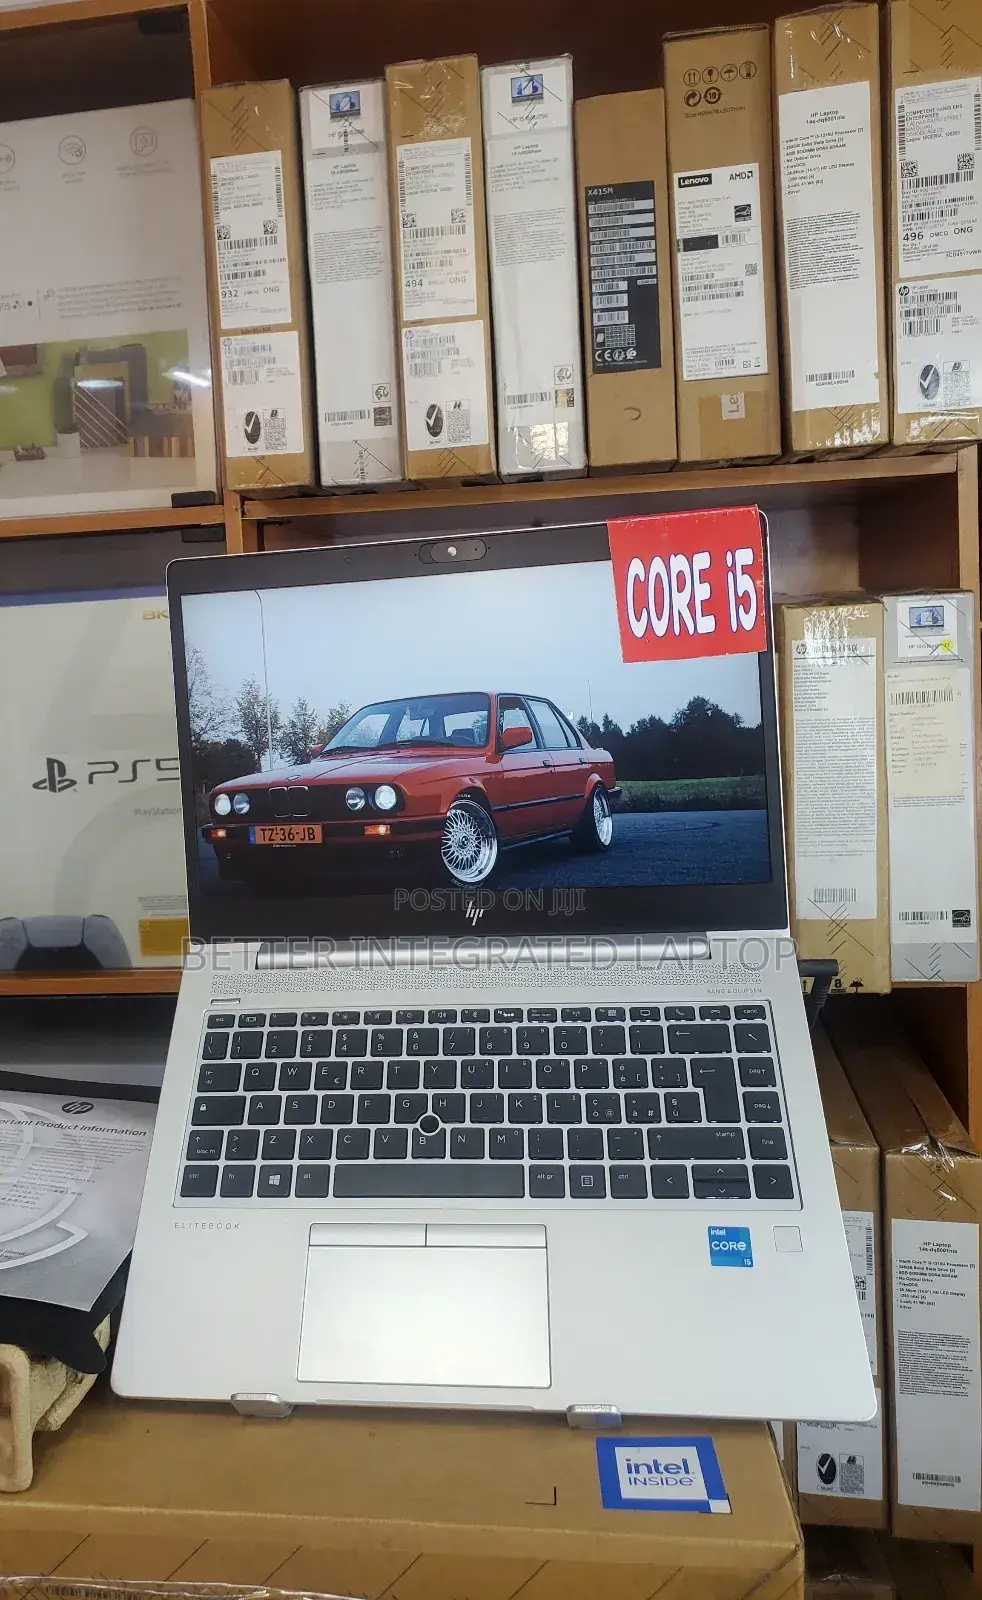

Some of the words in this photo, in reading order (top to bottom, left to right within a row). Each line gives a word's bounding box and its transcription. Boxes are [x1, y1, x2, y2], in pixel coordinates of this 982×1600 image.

[819, 109, 839, 117] Laptop
[906, 107, 935, 117] COMPETENT
[936, 103, 963, 111] HANDLERS
[906, 113, 940, 121] ENTERPRISES
[680, 176, 709, 186] Lenovo
[729, 171, 747, 181] AMD
[587, 187, 614, 196] X415M
[903, 231, 924, 242] 496
[954, 226, 974, 235] ONG
[405, 279, 423, 288] 494
[449, 276, 467, 284] ONG
[221, 289, 238, 298] 932
[263, 285, 280, 294] ONG
[626, 555, 716, 639] CORE
[725, 547, 757, 634] i5
[87, 757, 180, 785] PS5
[251, 1068, 260, 1076] Q
[431, 1066, 438, 1074] Y
[468, 1066, 475, 1074] U
[581, 1065, 588, 1073] P
[256, 1101, 264, 1109] A
[292, 1101, 299, 1109] S
[328, 1101, 336, 1109] D
[364, 1100, 371, 1108] F
[439, 1099, 447, 1107] H
[35, 1120, 81, 1131] Product
[80, 1124, 147, 1137] Information
[306, 1135, 314, 1143] X
[343, 1135, 351, 1143] C
[381, 1135, 389, 1143] V
[458, 1135, 465, 1143] N
[497, 1135, 506, 1143] M
[174, 1222, 240, 1230] ELITEBOOK
[711, 1228, 726, 1236] intel
[626, 1458, 690, 1475] intel
